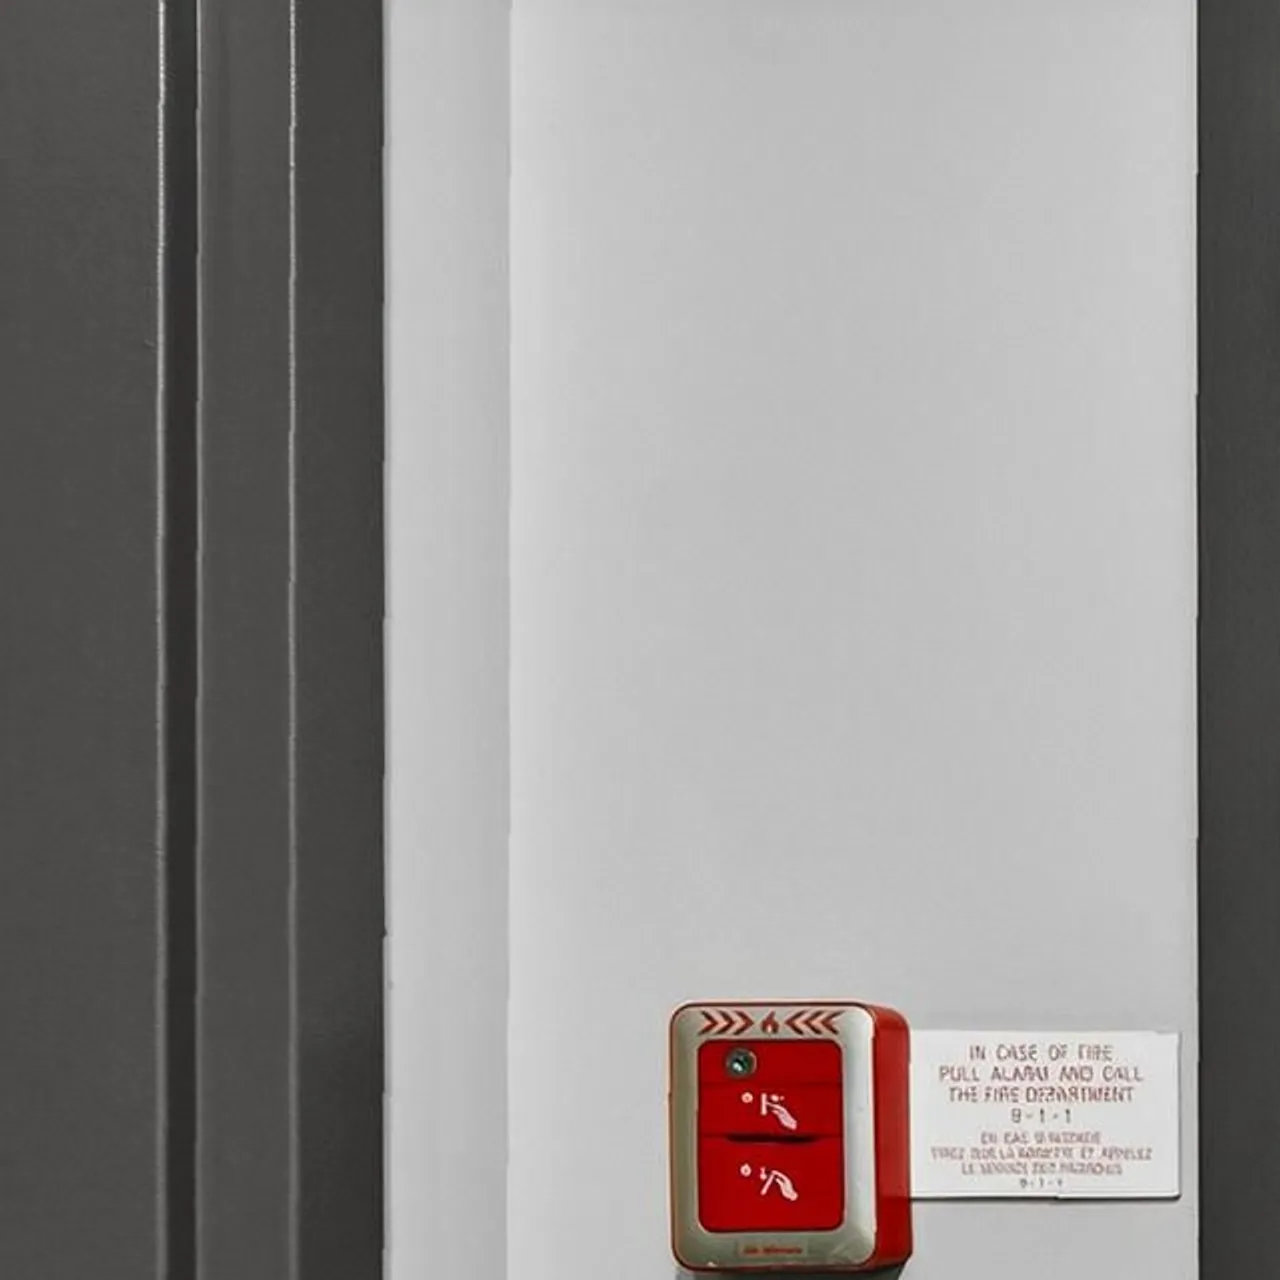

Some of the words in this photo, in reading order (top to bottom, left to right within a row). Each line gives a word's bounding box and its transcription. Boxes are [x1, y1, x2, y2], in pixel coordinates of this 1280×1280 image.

[968, 1044, 985, 1061] IN
[995, 1043, 1038, 1061] CASE
[1048, 1043, 1068, 1061] OF
[939, 1065, 981, 1082] PULL
[990, 1065, 1049, 1082] ALARM
[1060, 1065, 1094, 1082] AND
[1102, 1064, 1144, 1082] CALL
[949, 1086, 978, 1103] THE
[984, 1086, 1020, 1103] FIRE
[1025, 1086, 1134, 1103] DEPARTMENT
